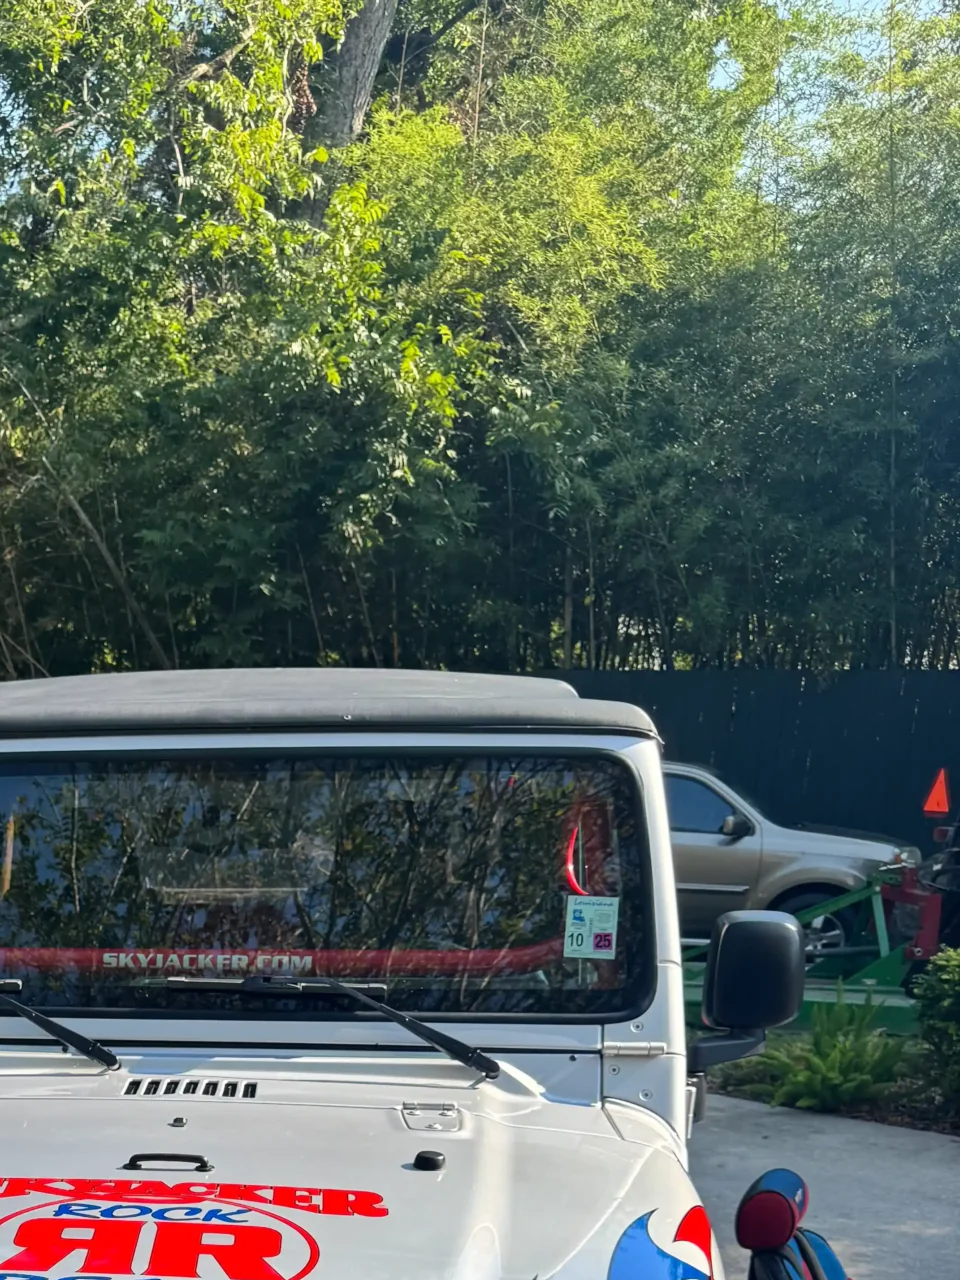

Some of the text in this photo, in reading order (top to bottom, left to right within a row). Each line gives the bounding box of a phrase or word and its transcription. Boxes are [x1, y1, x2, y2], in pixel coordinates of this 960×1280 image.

[568, 933, 584, 947] 10
[595, 934, 611, 948] 25
[103, 952, 313, 970] SKYJACKER.COM
[52, 1203, 249, 1223] ROCK
